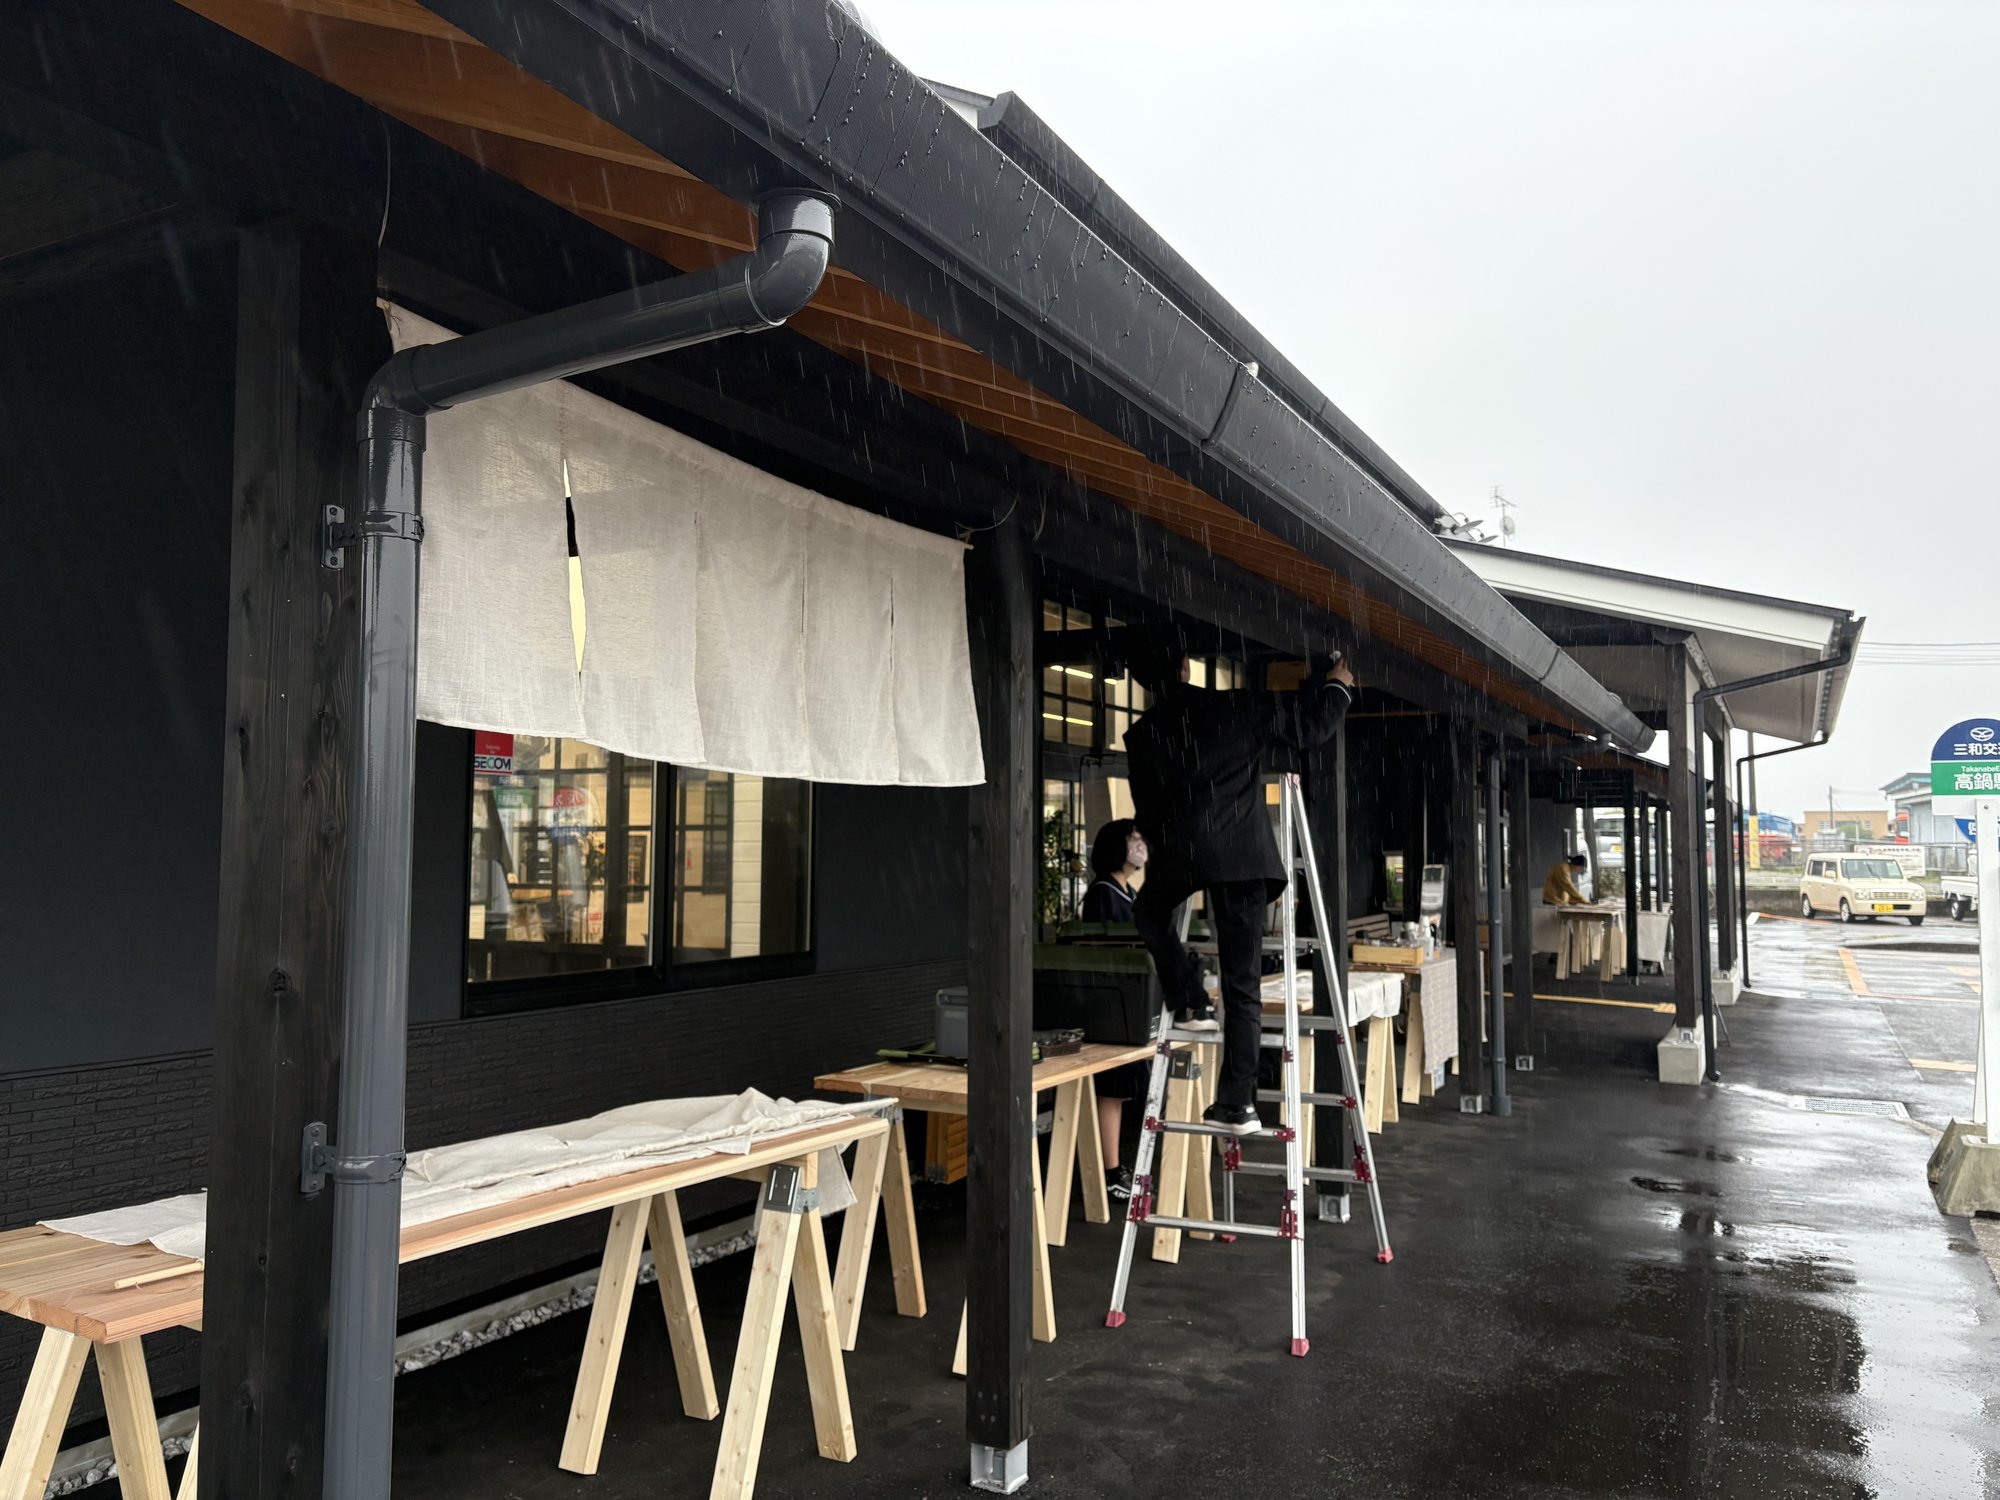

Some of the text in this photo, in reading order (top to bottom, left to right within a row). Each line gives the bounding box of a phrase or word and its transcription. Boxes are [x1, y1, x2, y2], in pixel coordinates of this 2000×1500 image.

[1953, 742, 2000, 756] 三和交
[474, 756, 511, 770] SECOM
